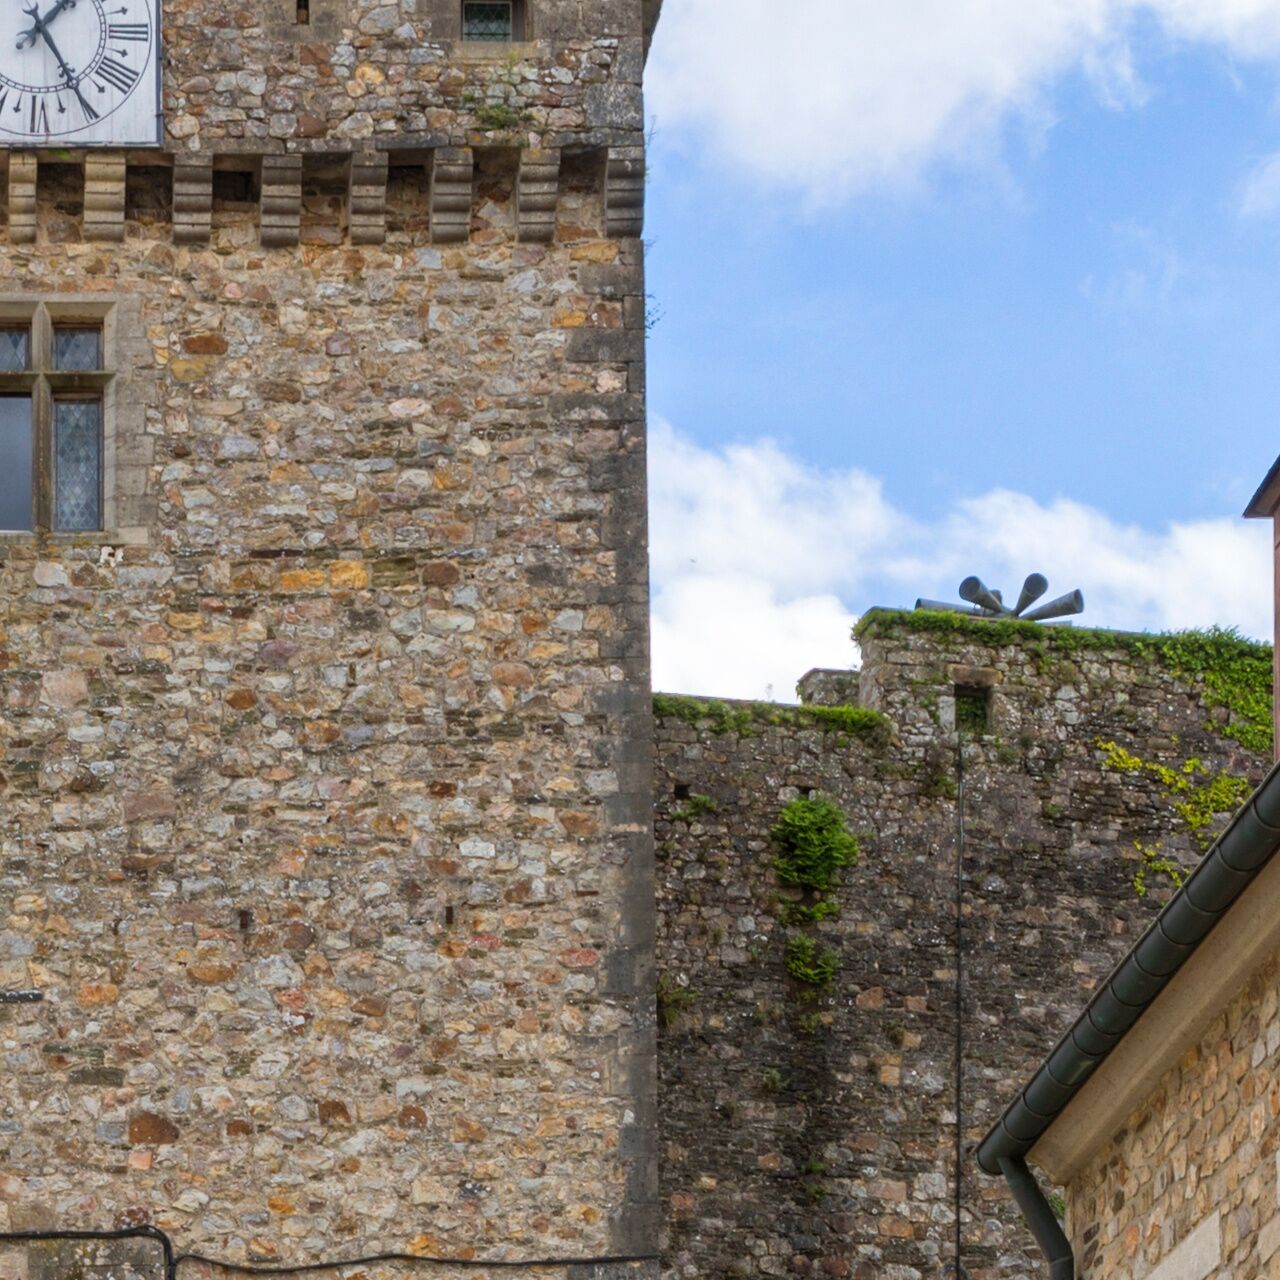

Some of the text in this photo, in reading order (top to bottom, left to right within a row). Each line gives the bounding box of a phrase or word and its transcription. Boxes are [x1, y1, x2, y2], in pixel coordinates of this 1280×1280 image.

[108, 23, 148, 42] III
[95, 55, 140, 96] IIII
[30, 94, 50, 133] VI
